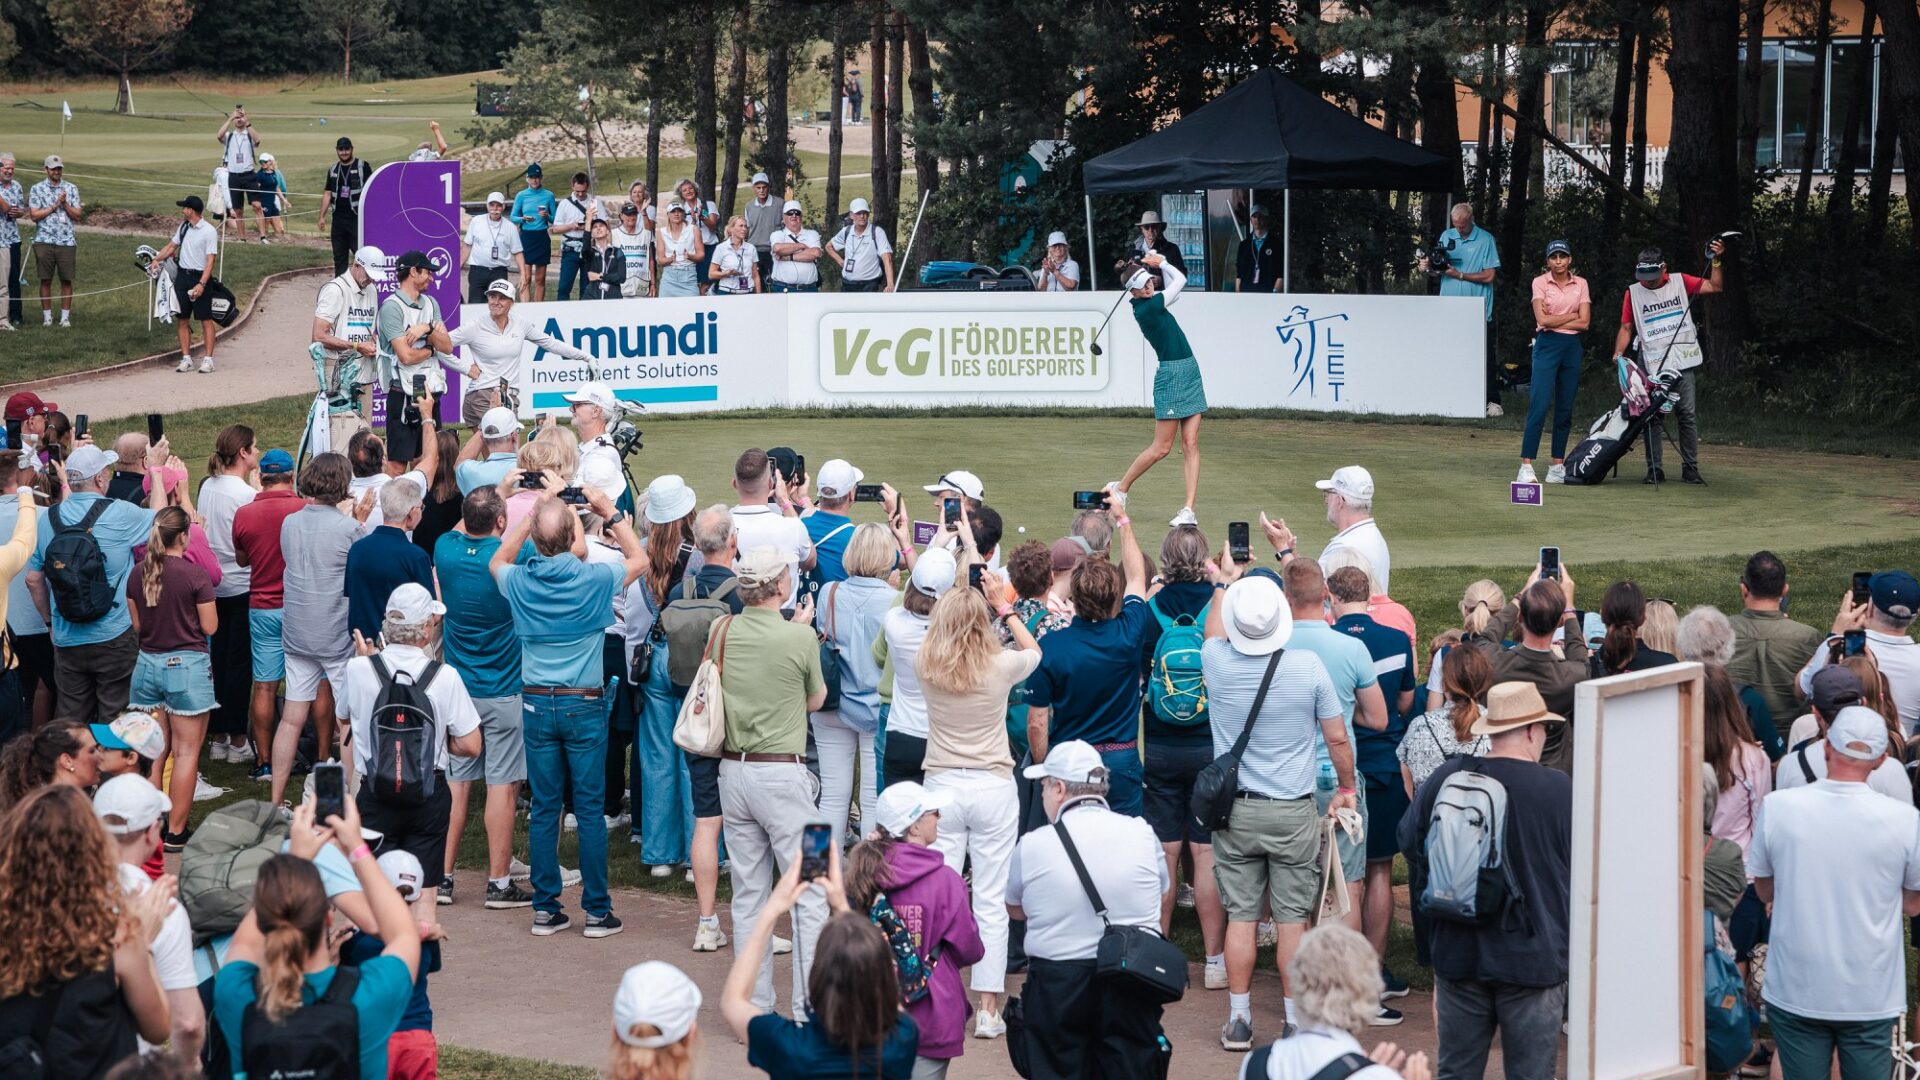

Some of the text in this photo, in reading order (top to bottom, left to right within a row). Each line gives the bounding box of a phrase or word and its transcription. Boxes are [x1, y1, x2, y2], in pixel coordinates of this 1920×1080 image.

[440, 173, 453, 204] 1
[1642, 295, 1681, 314] Amundi
[533, 311, 718, 361] Amundi
[951, 322, 1085, 356] FÖRDERER
[1647, 324, 1668, 337] DIKSHA
[833, 328, 933, 376] VcG
[951, 358, 1085, 377] DES GOLFSPORTS
[637, 363, 718, 379] Solutions
[1579, 442, 1603, 474] PING
